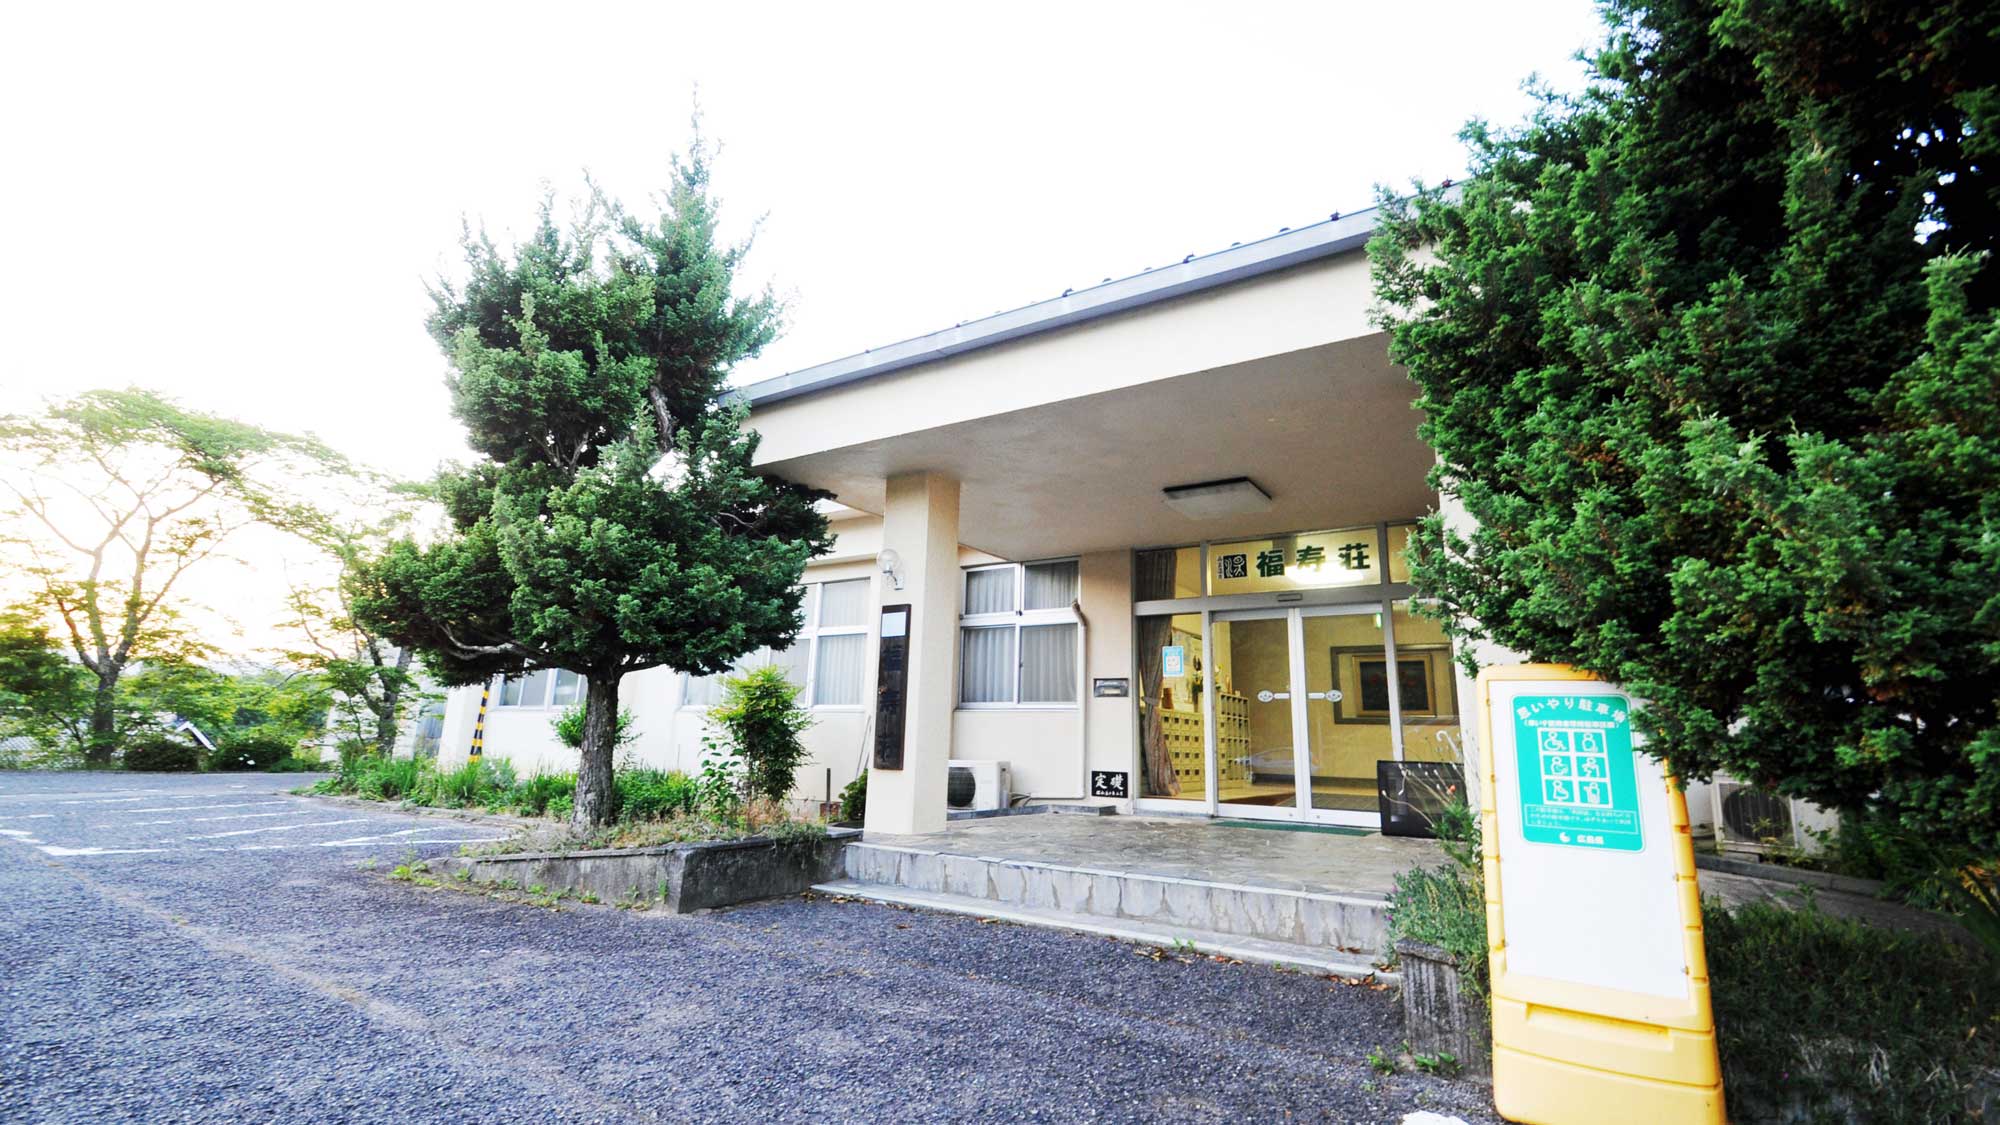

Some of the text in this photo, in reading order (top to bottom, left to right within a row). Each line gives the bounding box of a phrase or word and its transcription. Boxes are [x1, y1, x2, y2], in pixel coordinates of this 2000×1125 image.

[1256, 543, 1371, 578] 福寿荘
[1517, 698, 1626, 723] 思いやり駐車場
[1095, 773, 1124, 790] 定礎
